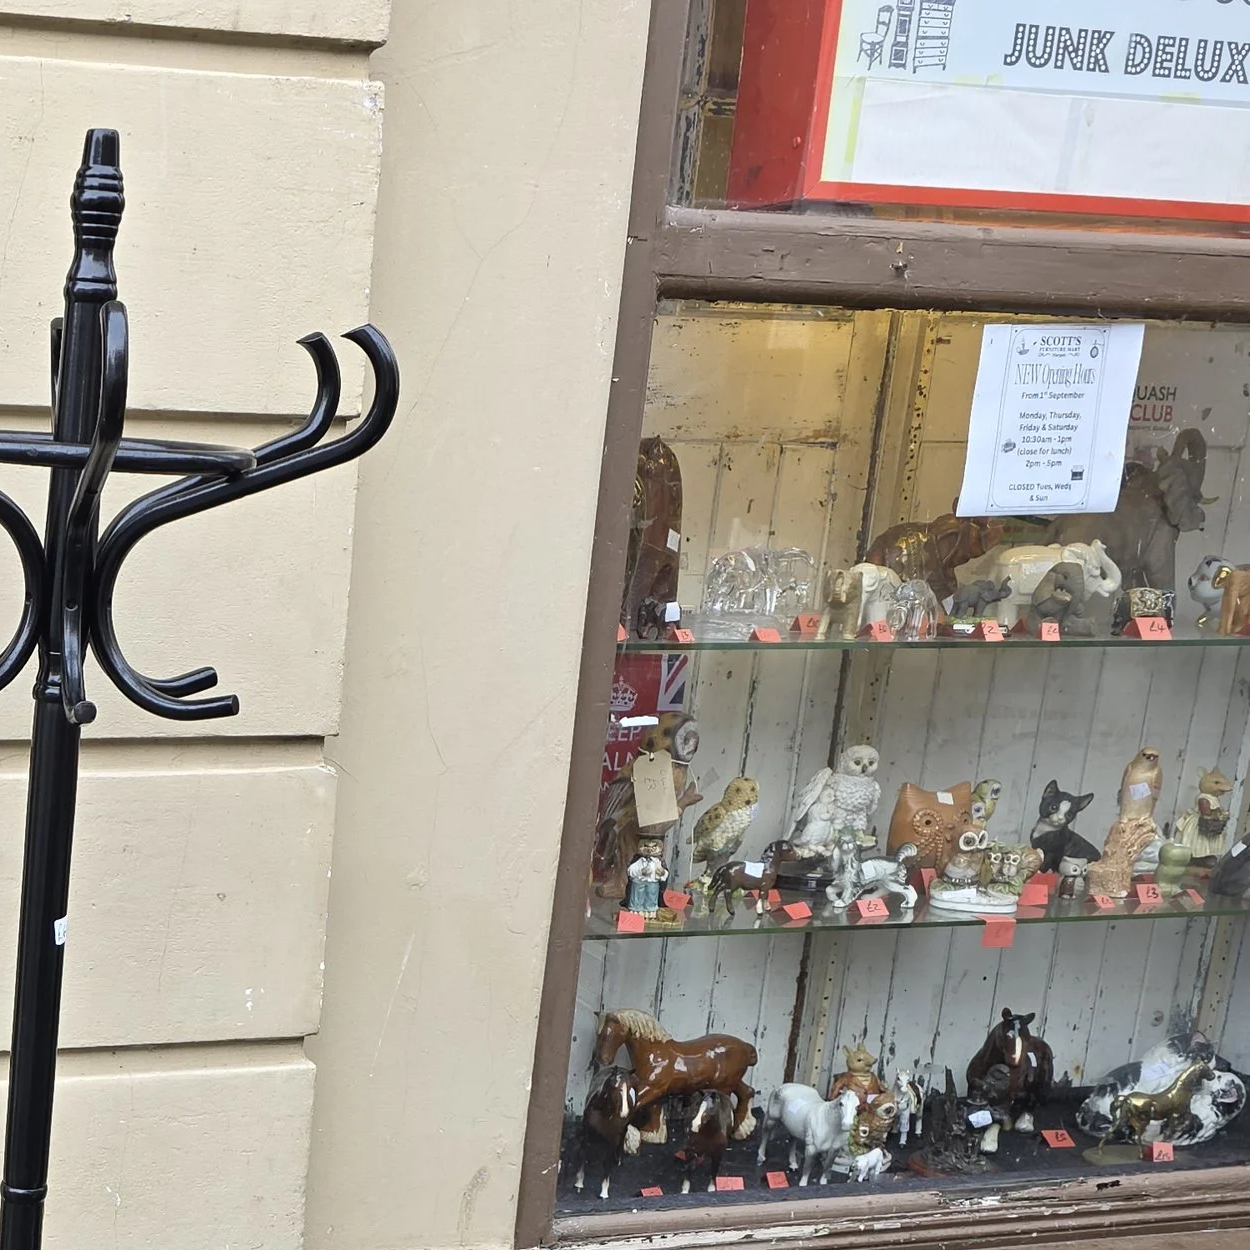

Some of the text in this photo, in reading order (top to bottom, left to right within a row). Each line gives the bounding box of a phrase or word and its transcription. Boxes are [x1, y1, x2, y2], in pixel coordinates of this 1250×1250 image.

[1003, 23, 1250, 84] JUNK DELUX
[1040, 336, 1082, 346] SCOTT'S
[1014, 363, 1096, 389] NEW Opening Hours
[1021, 391, 1085, 400] From 1st September
[1133, 386, 1177, 401] UASH
[1019, 411, 1082, 421] Monday, Thursday,
[1130, 403, 1173, 422] CLUB
[1019, 423, 1040, 433] Friday
[1048, 423, 1078, 432] Saturday
[1022, 435, 1052, 443] 10:30am
[1057, 435, 1072, 444] 1pm
[1017, 447, 1072, 456] (close for lunch)
[1025, 460, 1041, 469] 2pm
[1046, 460, 1062, 468] 5pm
[1009, 483, 1035, 491] CLOSED
[1037, 483, 1053, 491] Tues,
[606, 724, 641, 742] EEP
[602, 751, 634, 771] AL
